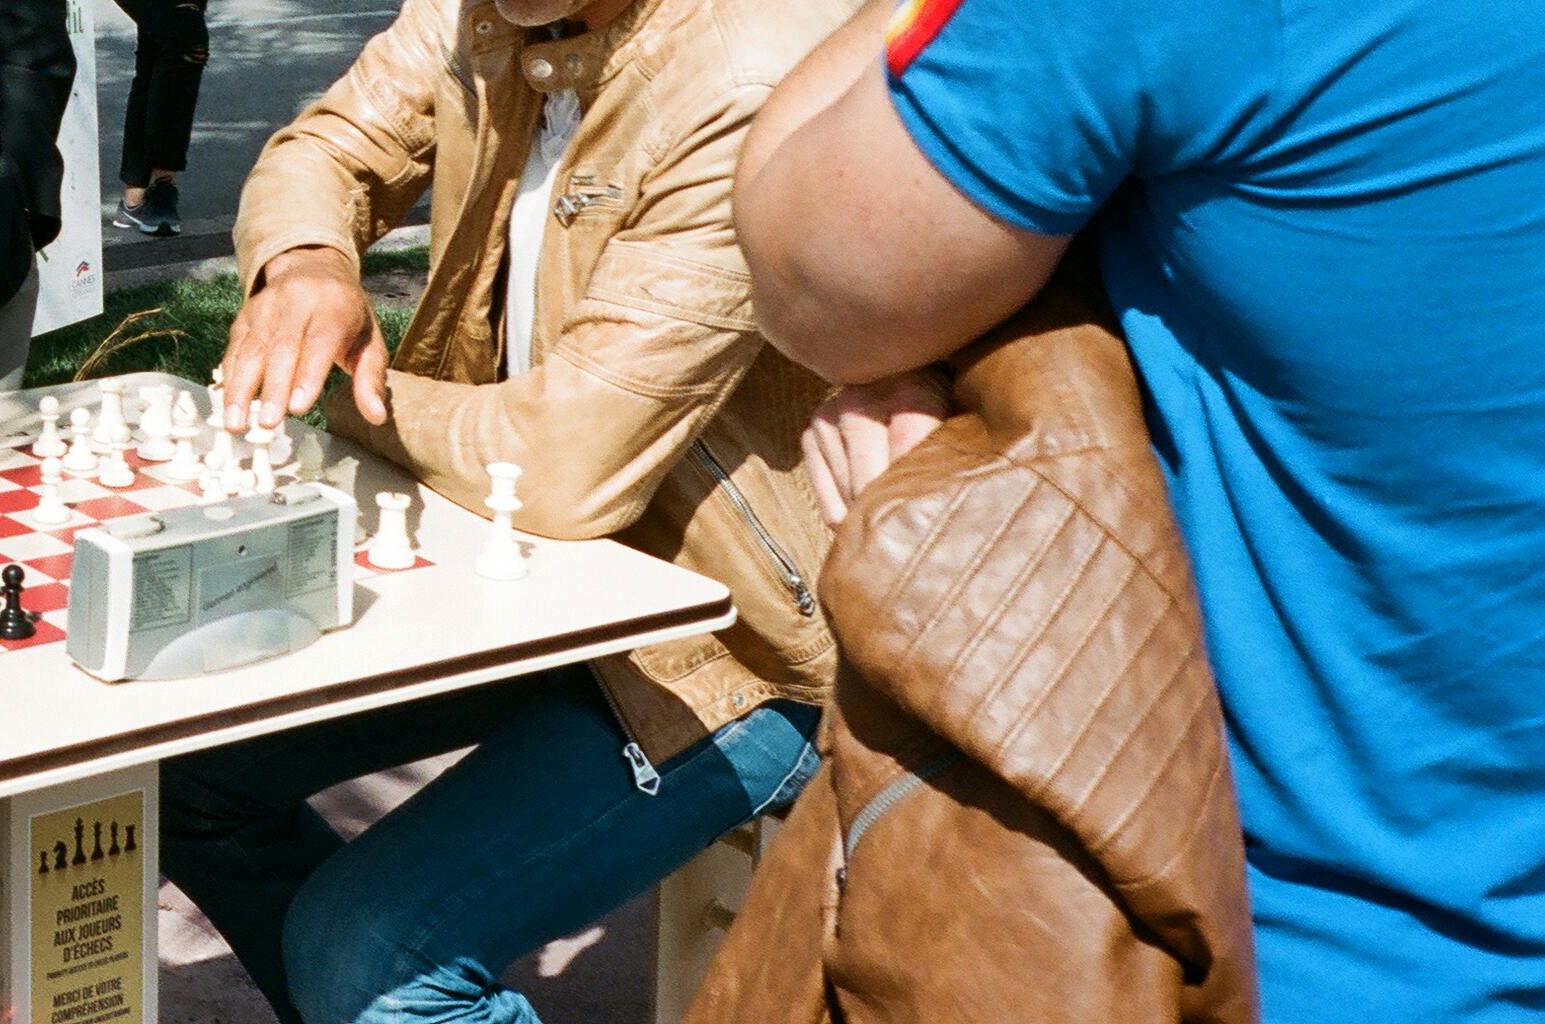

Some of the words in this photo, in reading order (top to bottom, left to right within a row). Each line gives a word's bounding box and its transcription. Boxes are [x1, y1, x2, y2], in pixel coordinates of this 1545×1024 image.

[56, 894, 120, 926] PRIORITAIRE
[53, 926, 77, 947] AUX
[78, 915, 122, 941] JOUEURS
[52, 988, 81, 1008] MERCI
[82, 984, 94, 1000] DE
[95, 976, 122, 996] VOTRE
